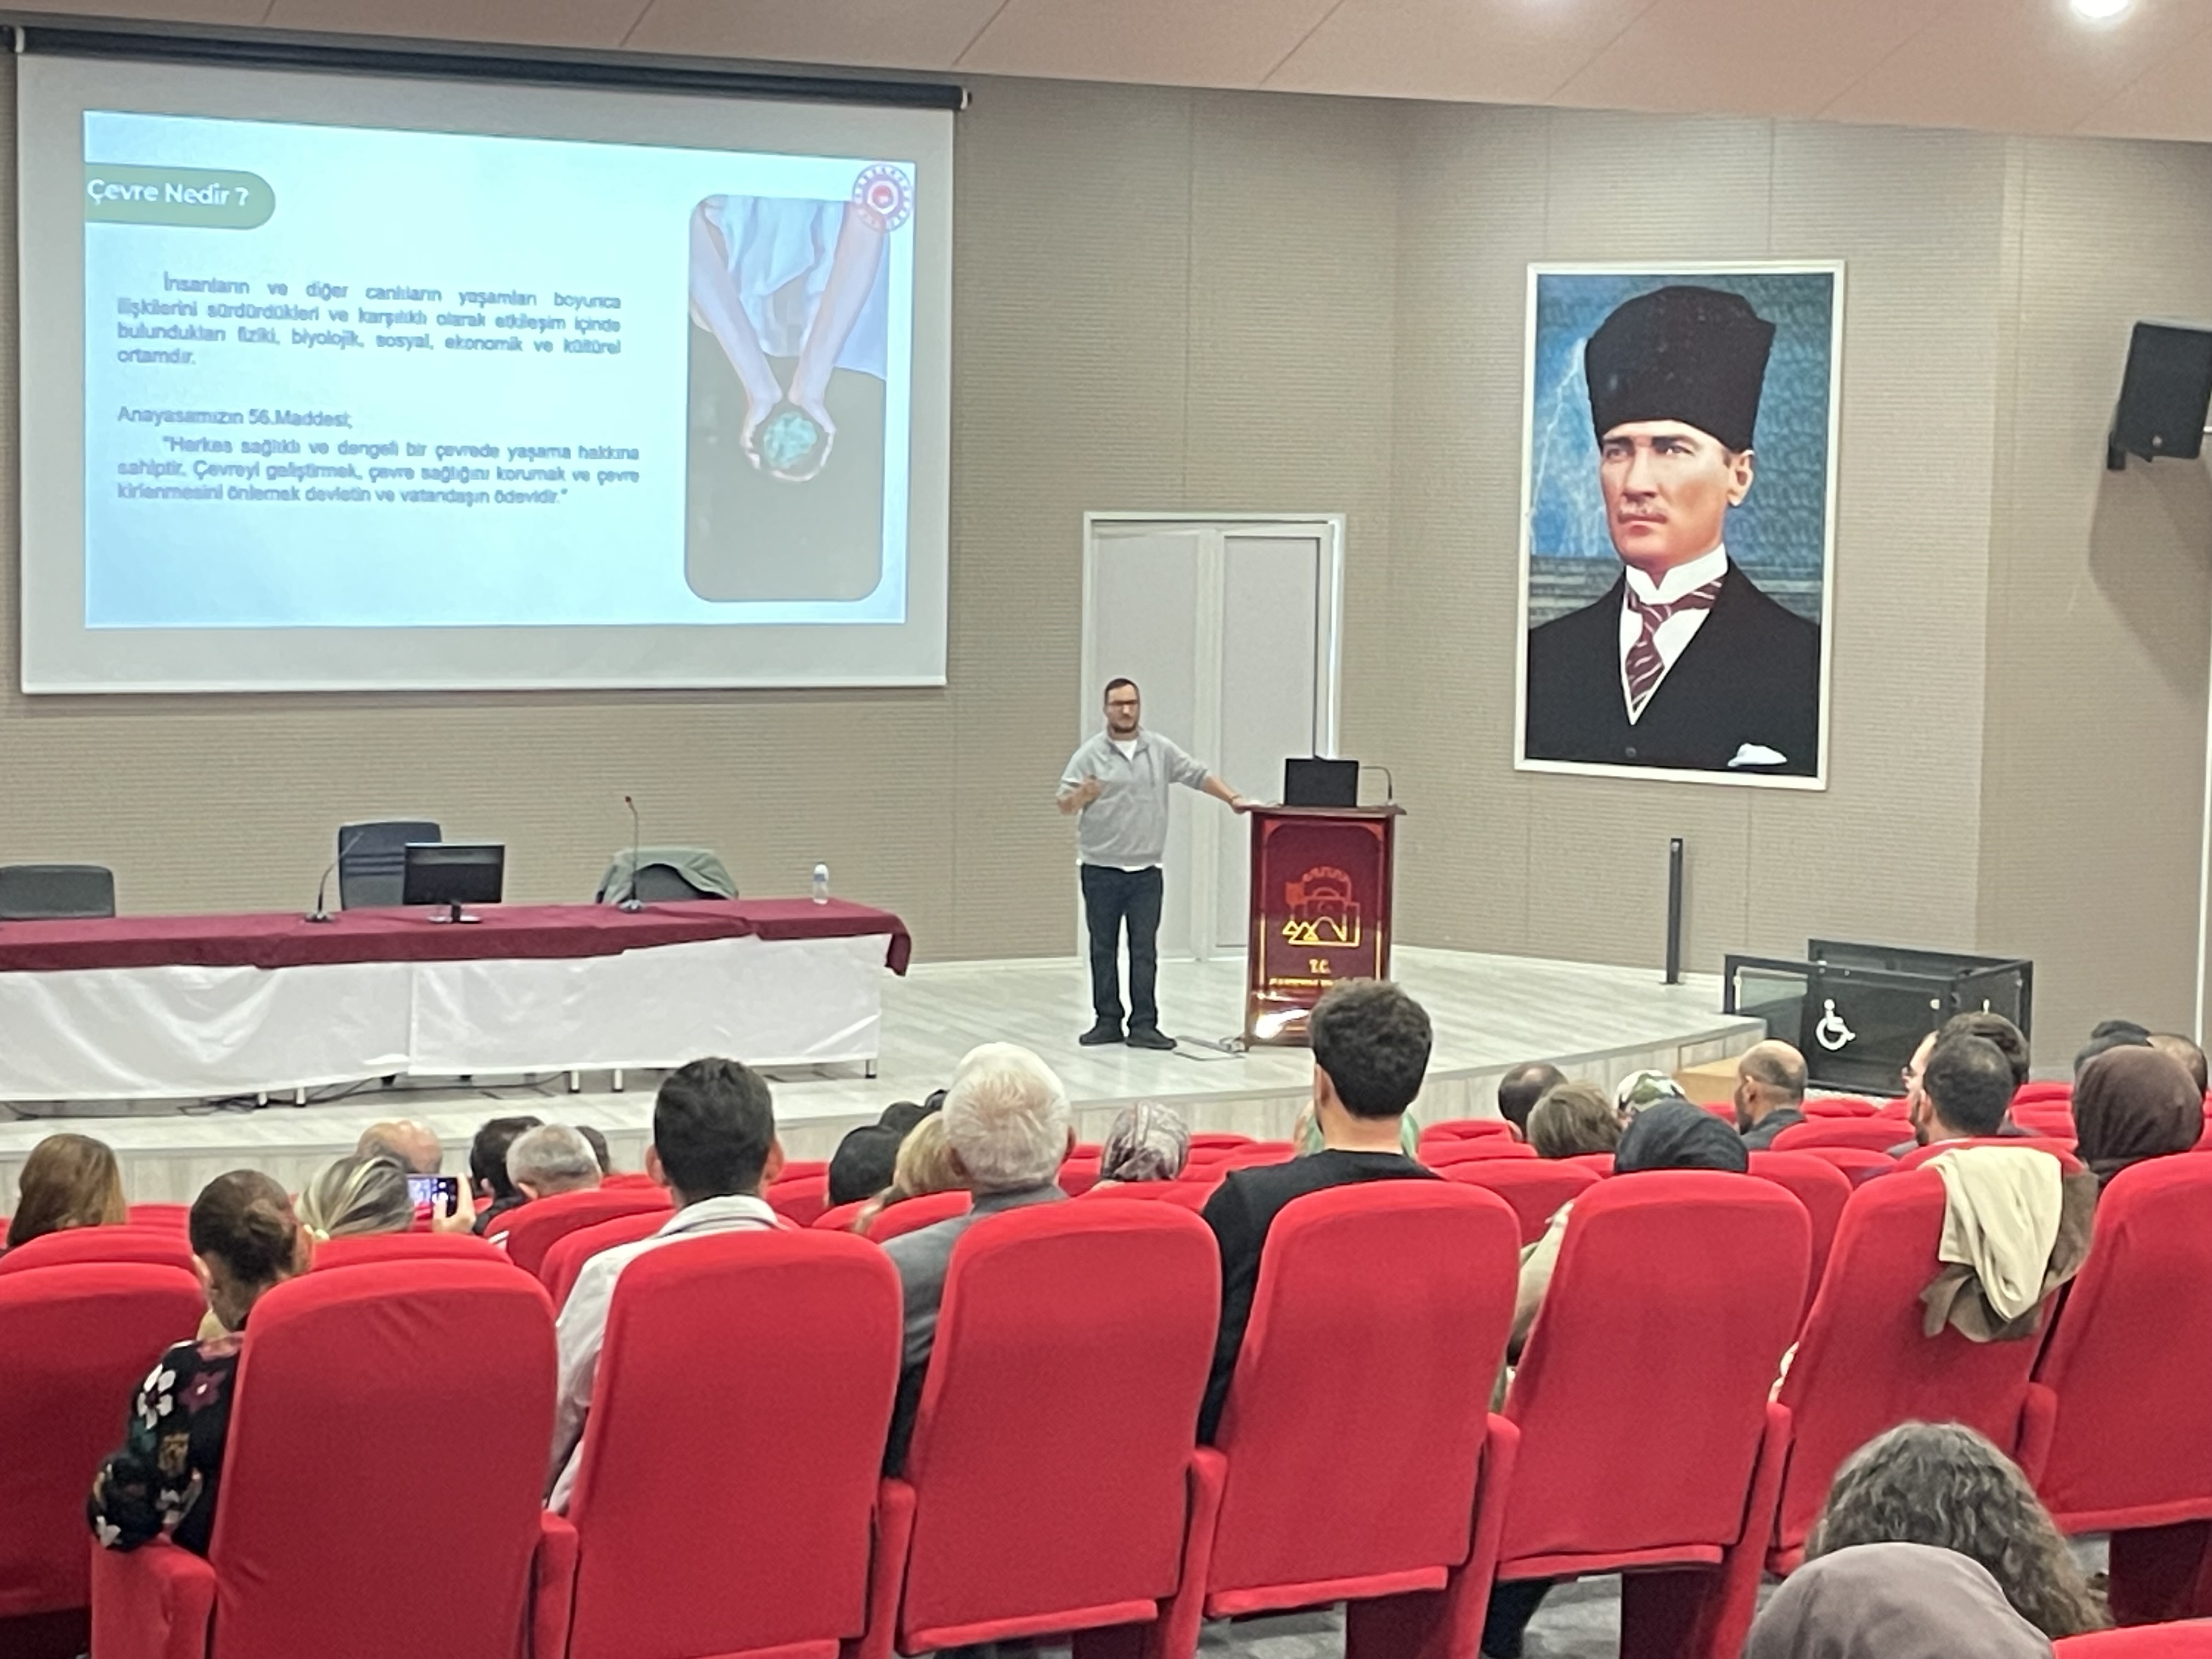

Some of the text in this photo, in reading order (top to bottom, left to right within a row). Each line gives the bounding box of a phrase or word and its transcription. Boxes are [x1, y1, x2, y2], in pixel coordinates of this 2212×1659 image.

[87, 179, 249, 206] Çevre Nedir ?
[267, 283, 287, 296] ve
[554, 292, 621, 311] boyunca
[329, 309, 348, 322] ve
[533, 341, 553, 353] ve
[309, 443, 329, 454] ve
[572, 470, 590, 482] ve
[375, 490, 395, 501] ve
